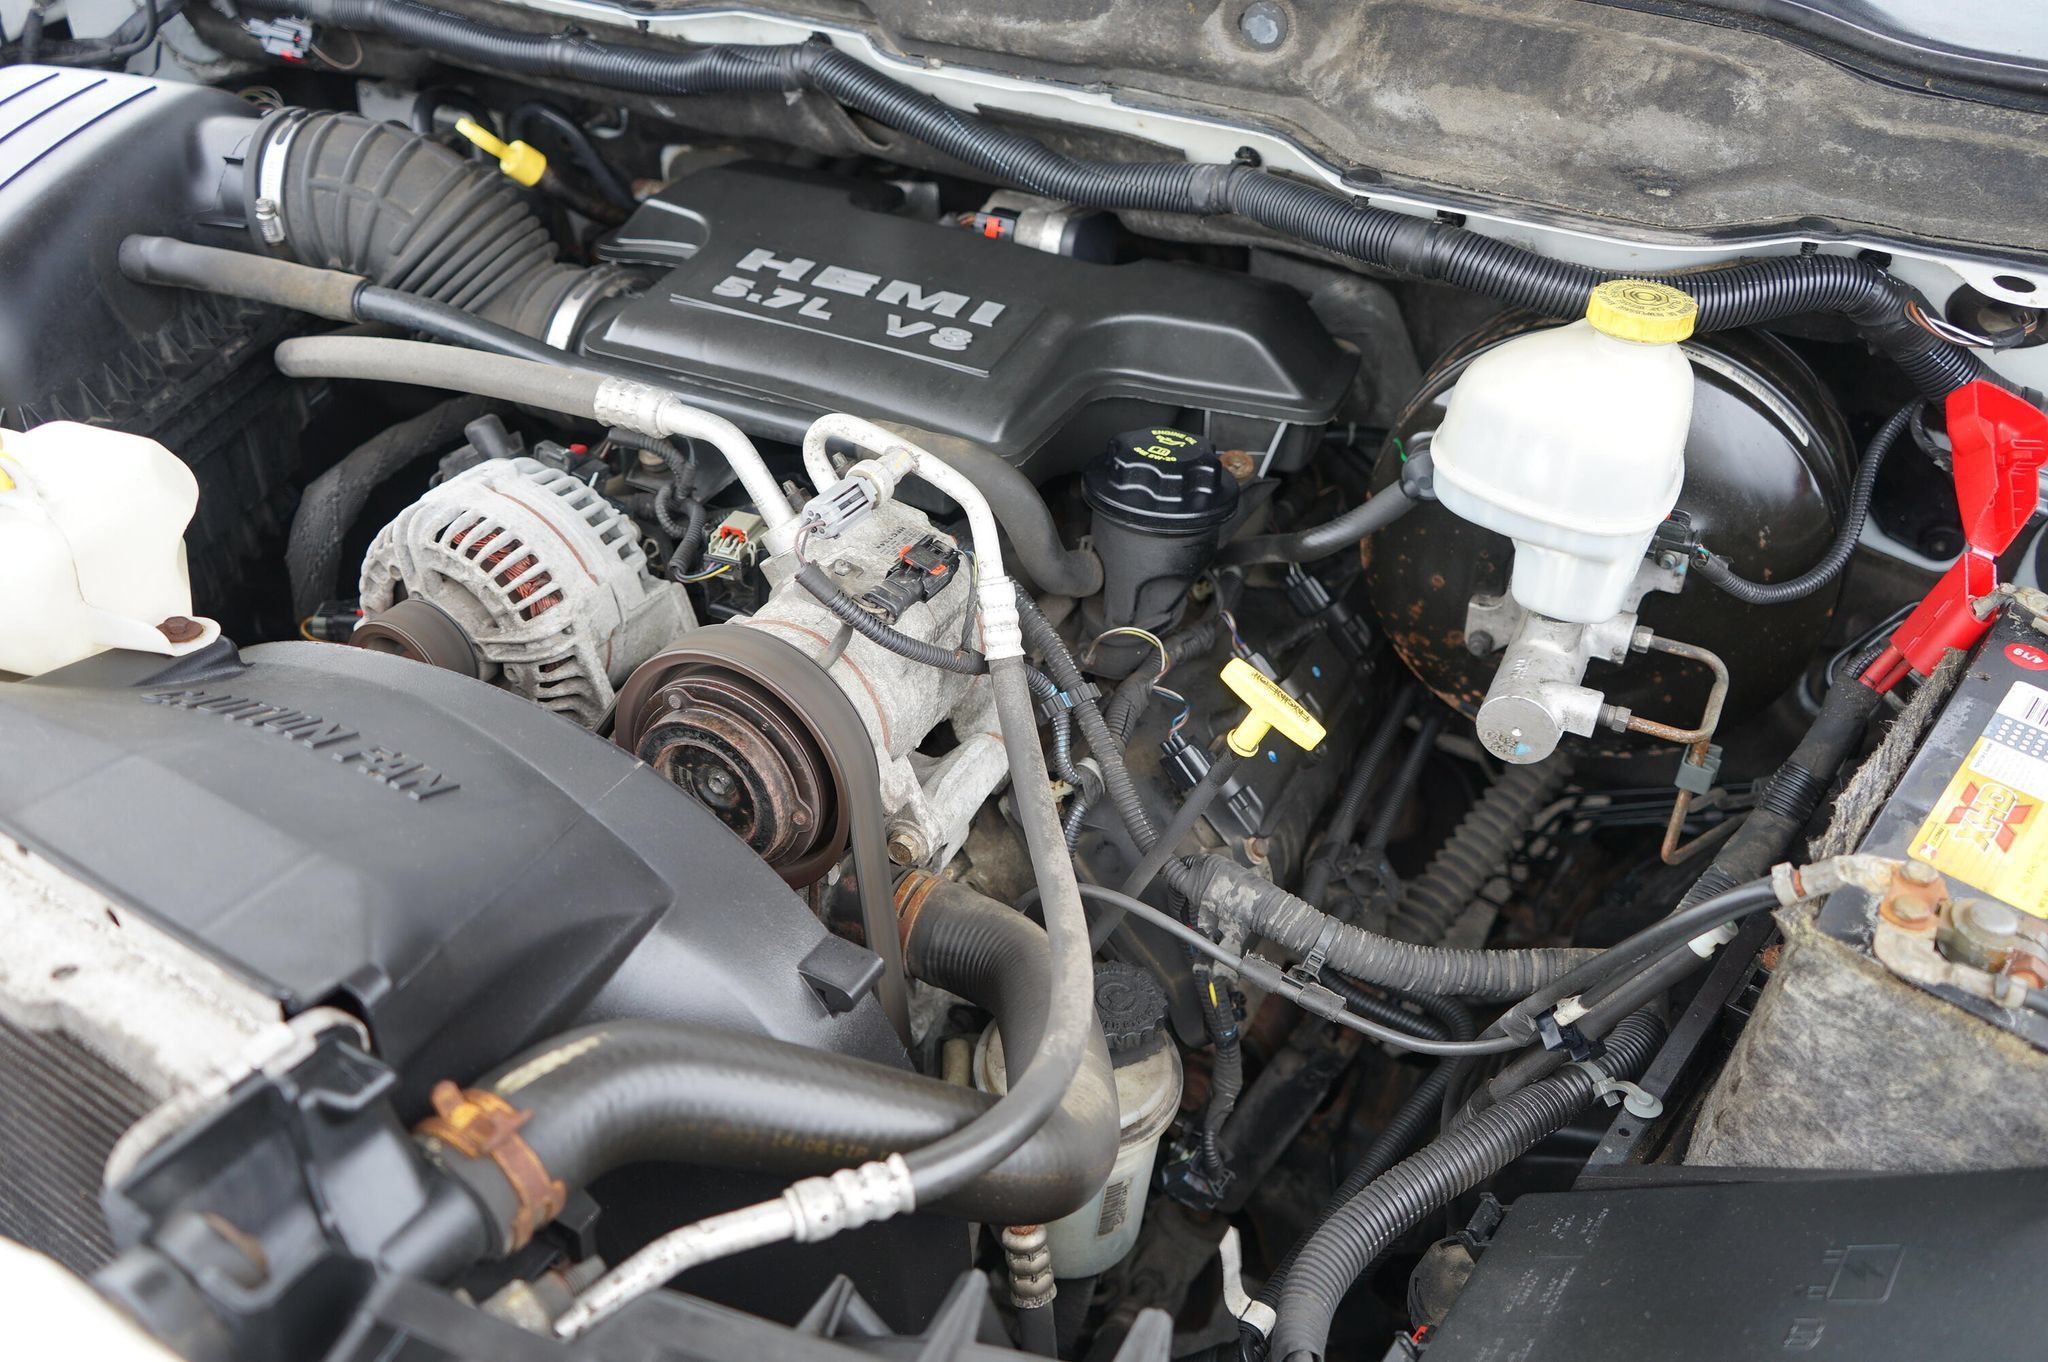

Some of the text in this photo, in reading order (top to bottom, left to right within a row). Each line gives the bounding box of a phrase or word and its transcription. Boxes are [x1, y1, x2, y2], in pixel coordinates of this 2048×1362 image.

[712, 275, 973, 351] 5.7L V8
[736, 248, 1006, 328] HEMI
[1151, 429, 1187, 439] ENGINE
[2012, 647, 2045, 664] 4/19
[141, 690, 460, 802] CAUTION FAN
